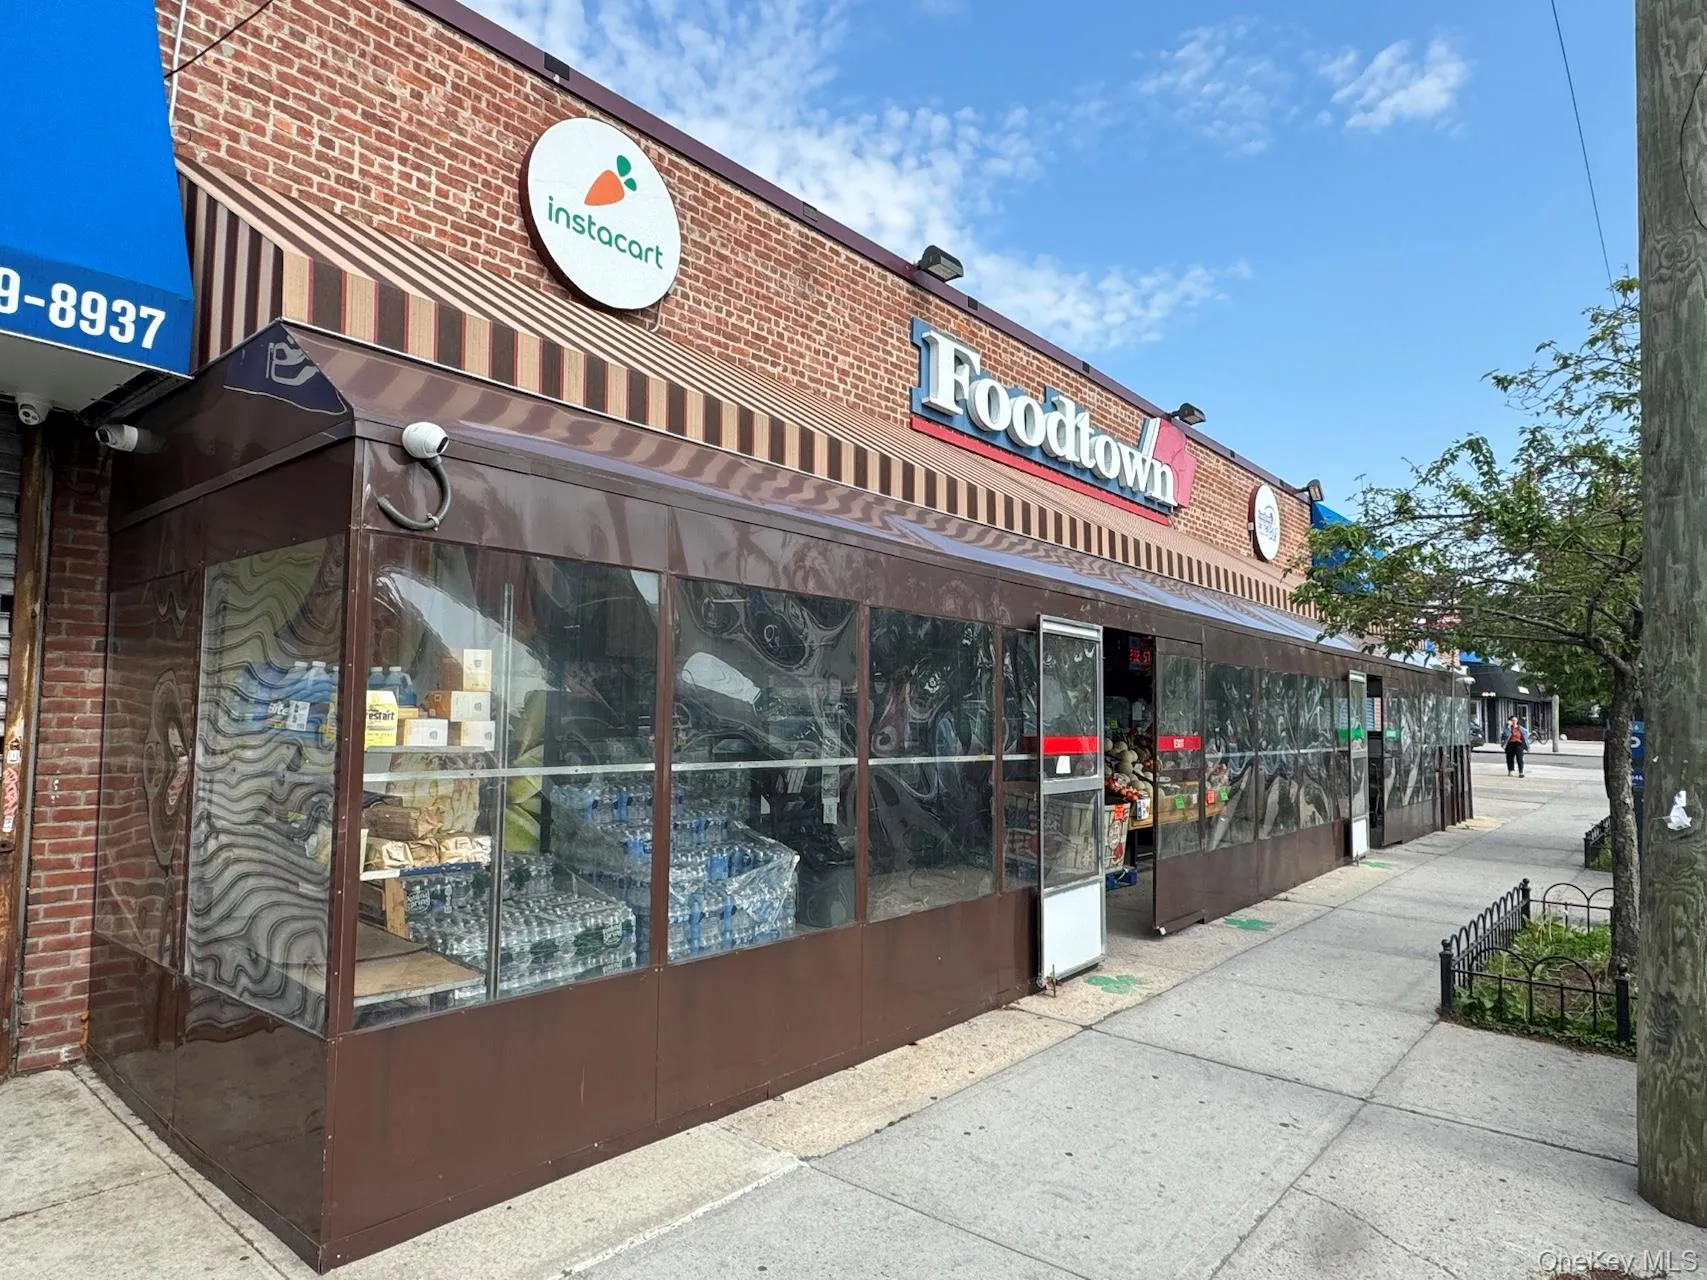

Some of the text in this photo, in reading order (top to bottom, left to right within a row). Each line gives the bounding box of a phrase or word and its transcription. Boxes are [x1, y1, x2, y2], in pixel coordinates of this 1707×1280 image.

[547, 195, 664, 270] instacart
[0, 266, 166, 350] 9-8937
[921, 329, 1179, 507] Foodtown
